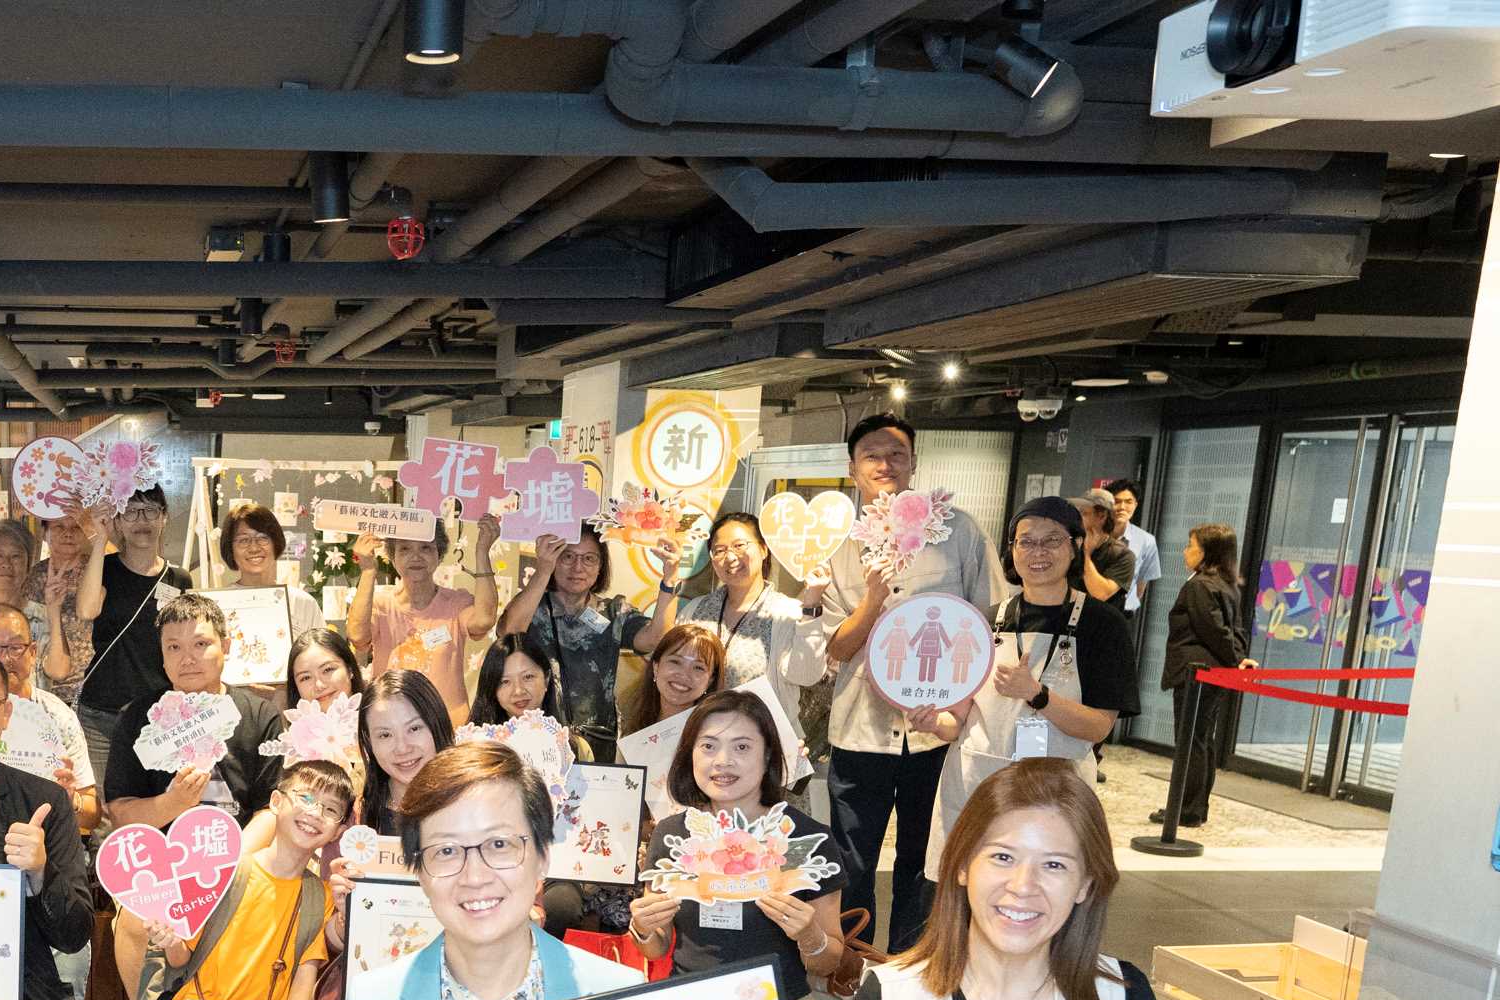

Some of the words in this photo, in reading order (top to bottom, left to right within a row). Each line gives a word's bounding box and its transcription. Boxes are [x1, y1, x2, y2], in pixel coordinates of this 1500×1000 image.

[663, 423, 708, 471] 新
[430, 443, 485, 498] 花
[522, 471, 576, 525] 墟
[901, 687, 950, 699] 融合共創
[108, 830, 153, 873] 花
[191, 818, 230, 857] 墟
[130, 888, 174, 906] Flower
[172, 890, 219, 917] Market
